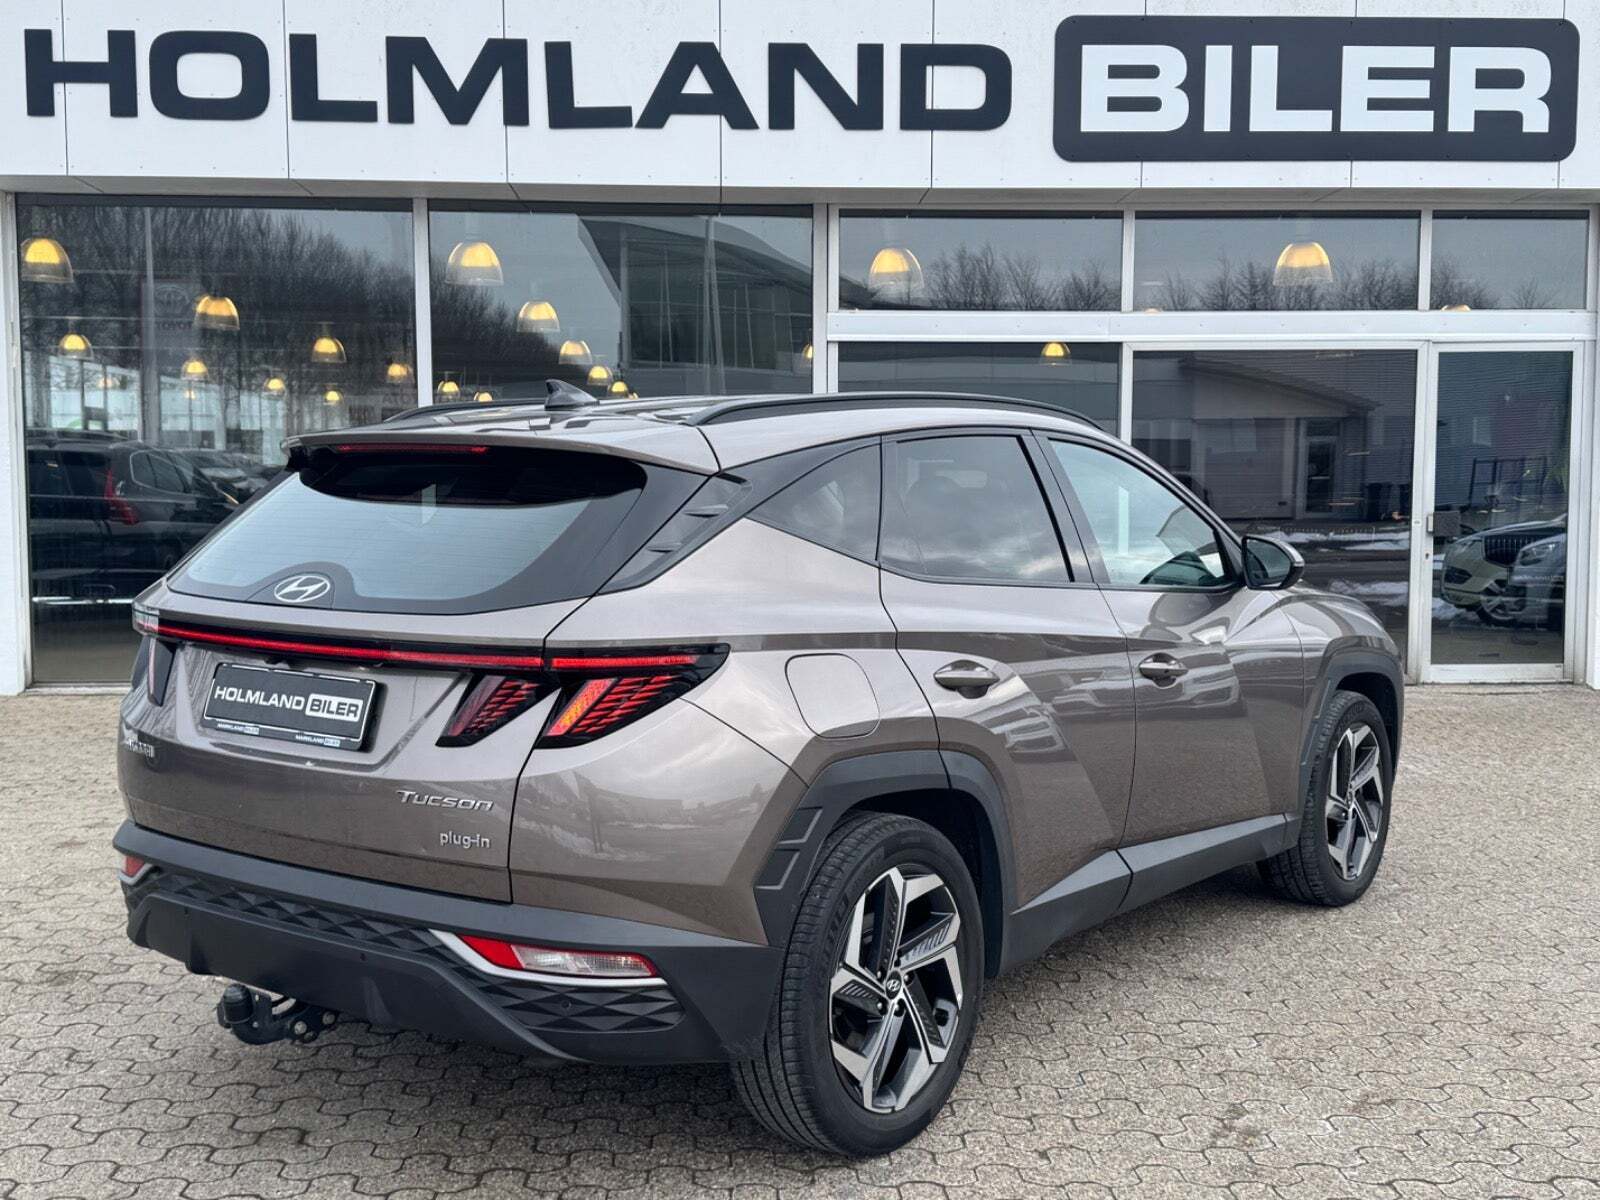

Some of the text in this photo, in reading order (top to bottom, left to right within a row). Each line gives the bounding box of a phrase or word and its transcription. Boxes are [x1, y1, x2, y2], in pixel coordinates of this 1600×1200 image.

[25, 29, 1551, 133] HOLMLAND BILER
[214, 686, 359, 718] HOLMLAND BILER
[440, 831, 490, 849] plug-in
